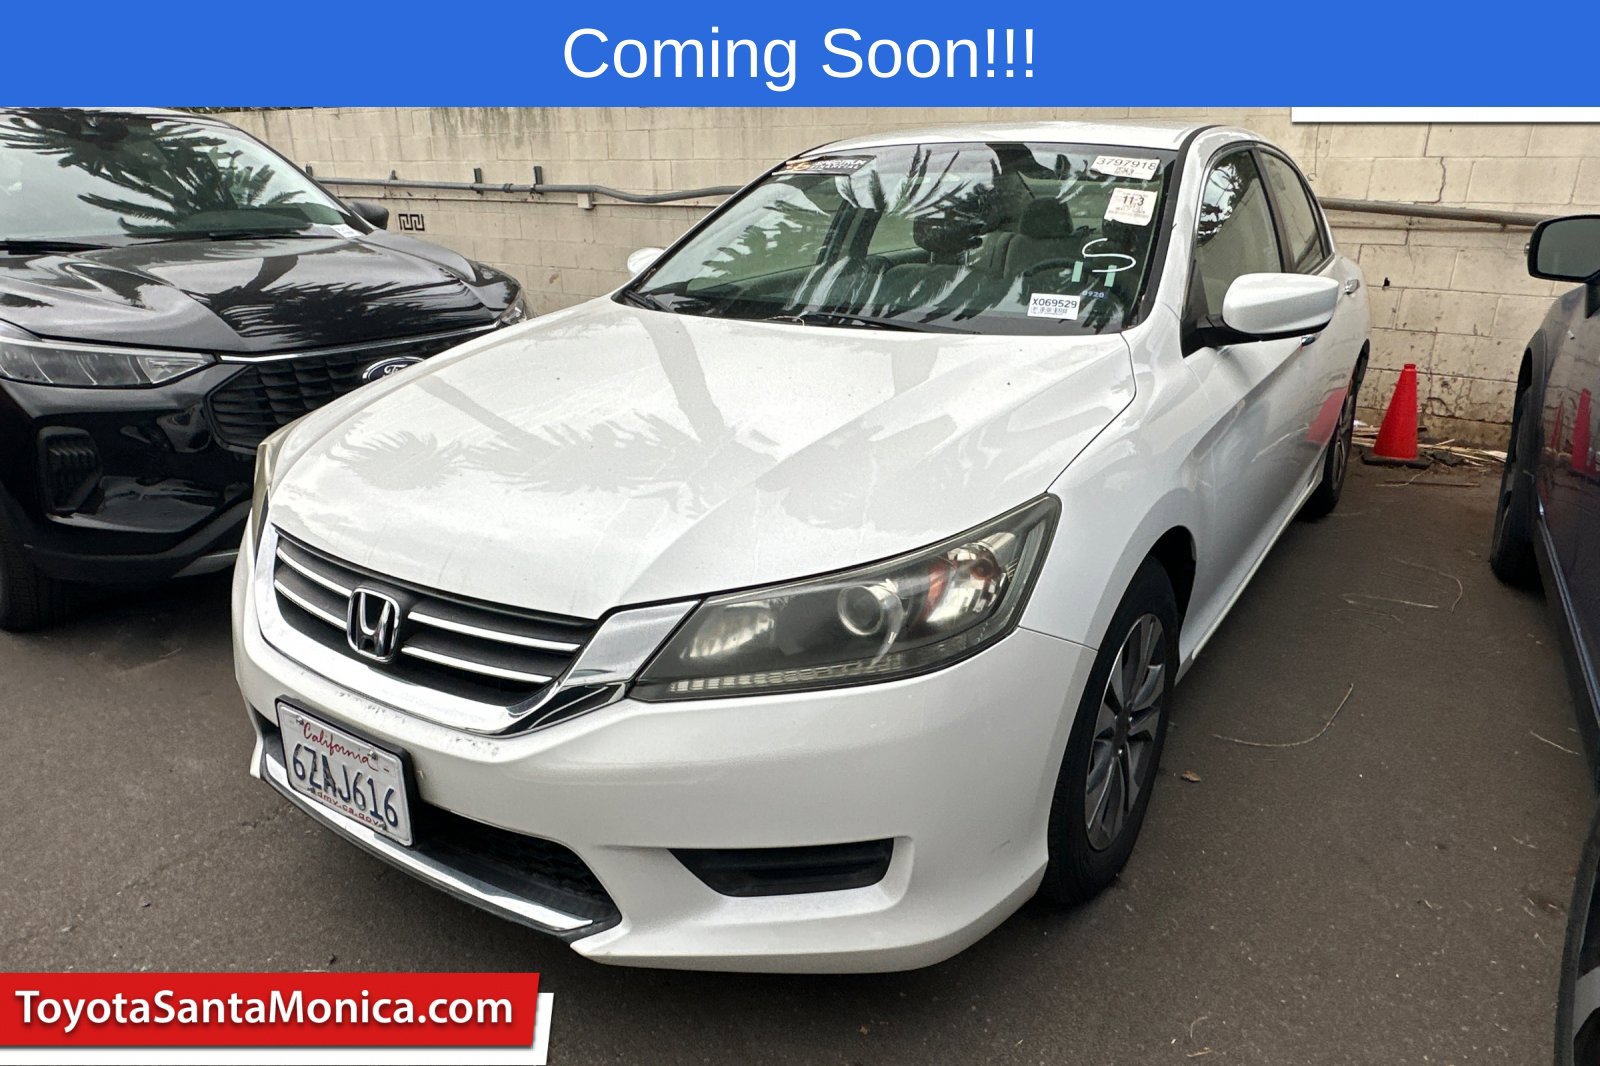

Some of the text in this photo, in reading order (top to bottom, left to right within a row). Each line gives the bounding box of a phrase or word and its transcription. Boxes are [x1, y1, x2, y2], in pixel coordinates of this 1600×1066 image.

[1096, 157, 1157, 171] 3797918
[1032, 298, 1078, 308] X069529
[303, 722, 378, 772] California
[292, 743, 399, 828] 6ZAJ616
